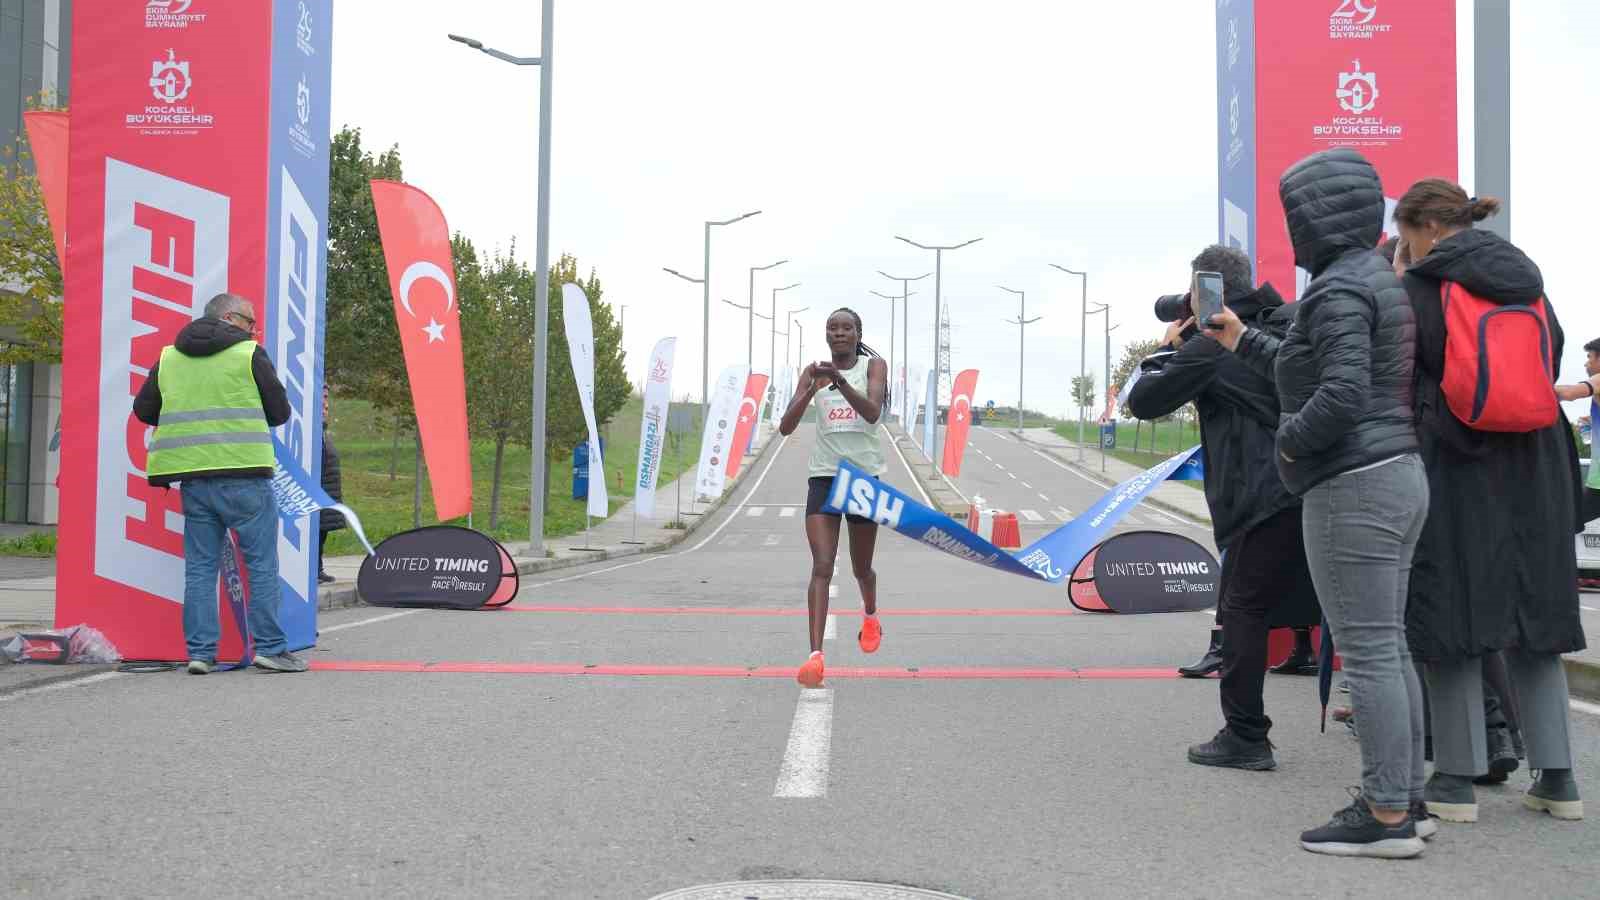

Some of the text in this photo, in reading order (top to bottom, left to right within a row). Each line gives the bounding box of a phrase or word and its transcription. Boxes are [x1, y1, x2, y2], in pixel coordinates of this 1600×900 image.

[829, 468, 904, 530] ISH
[375, 557, 489, 573] UNITED TIMING
[1105, 561, 1209, 577] UNITED TIMING
[431, 580, 487, 591] RACE RESULT
[1164, 583, 1215, 593] RACE RESULT
